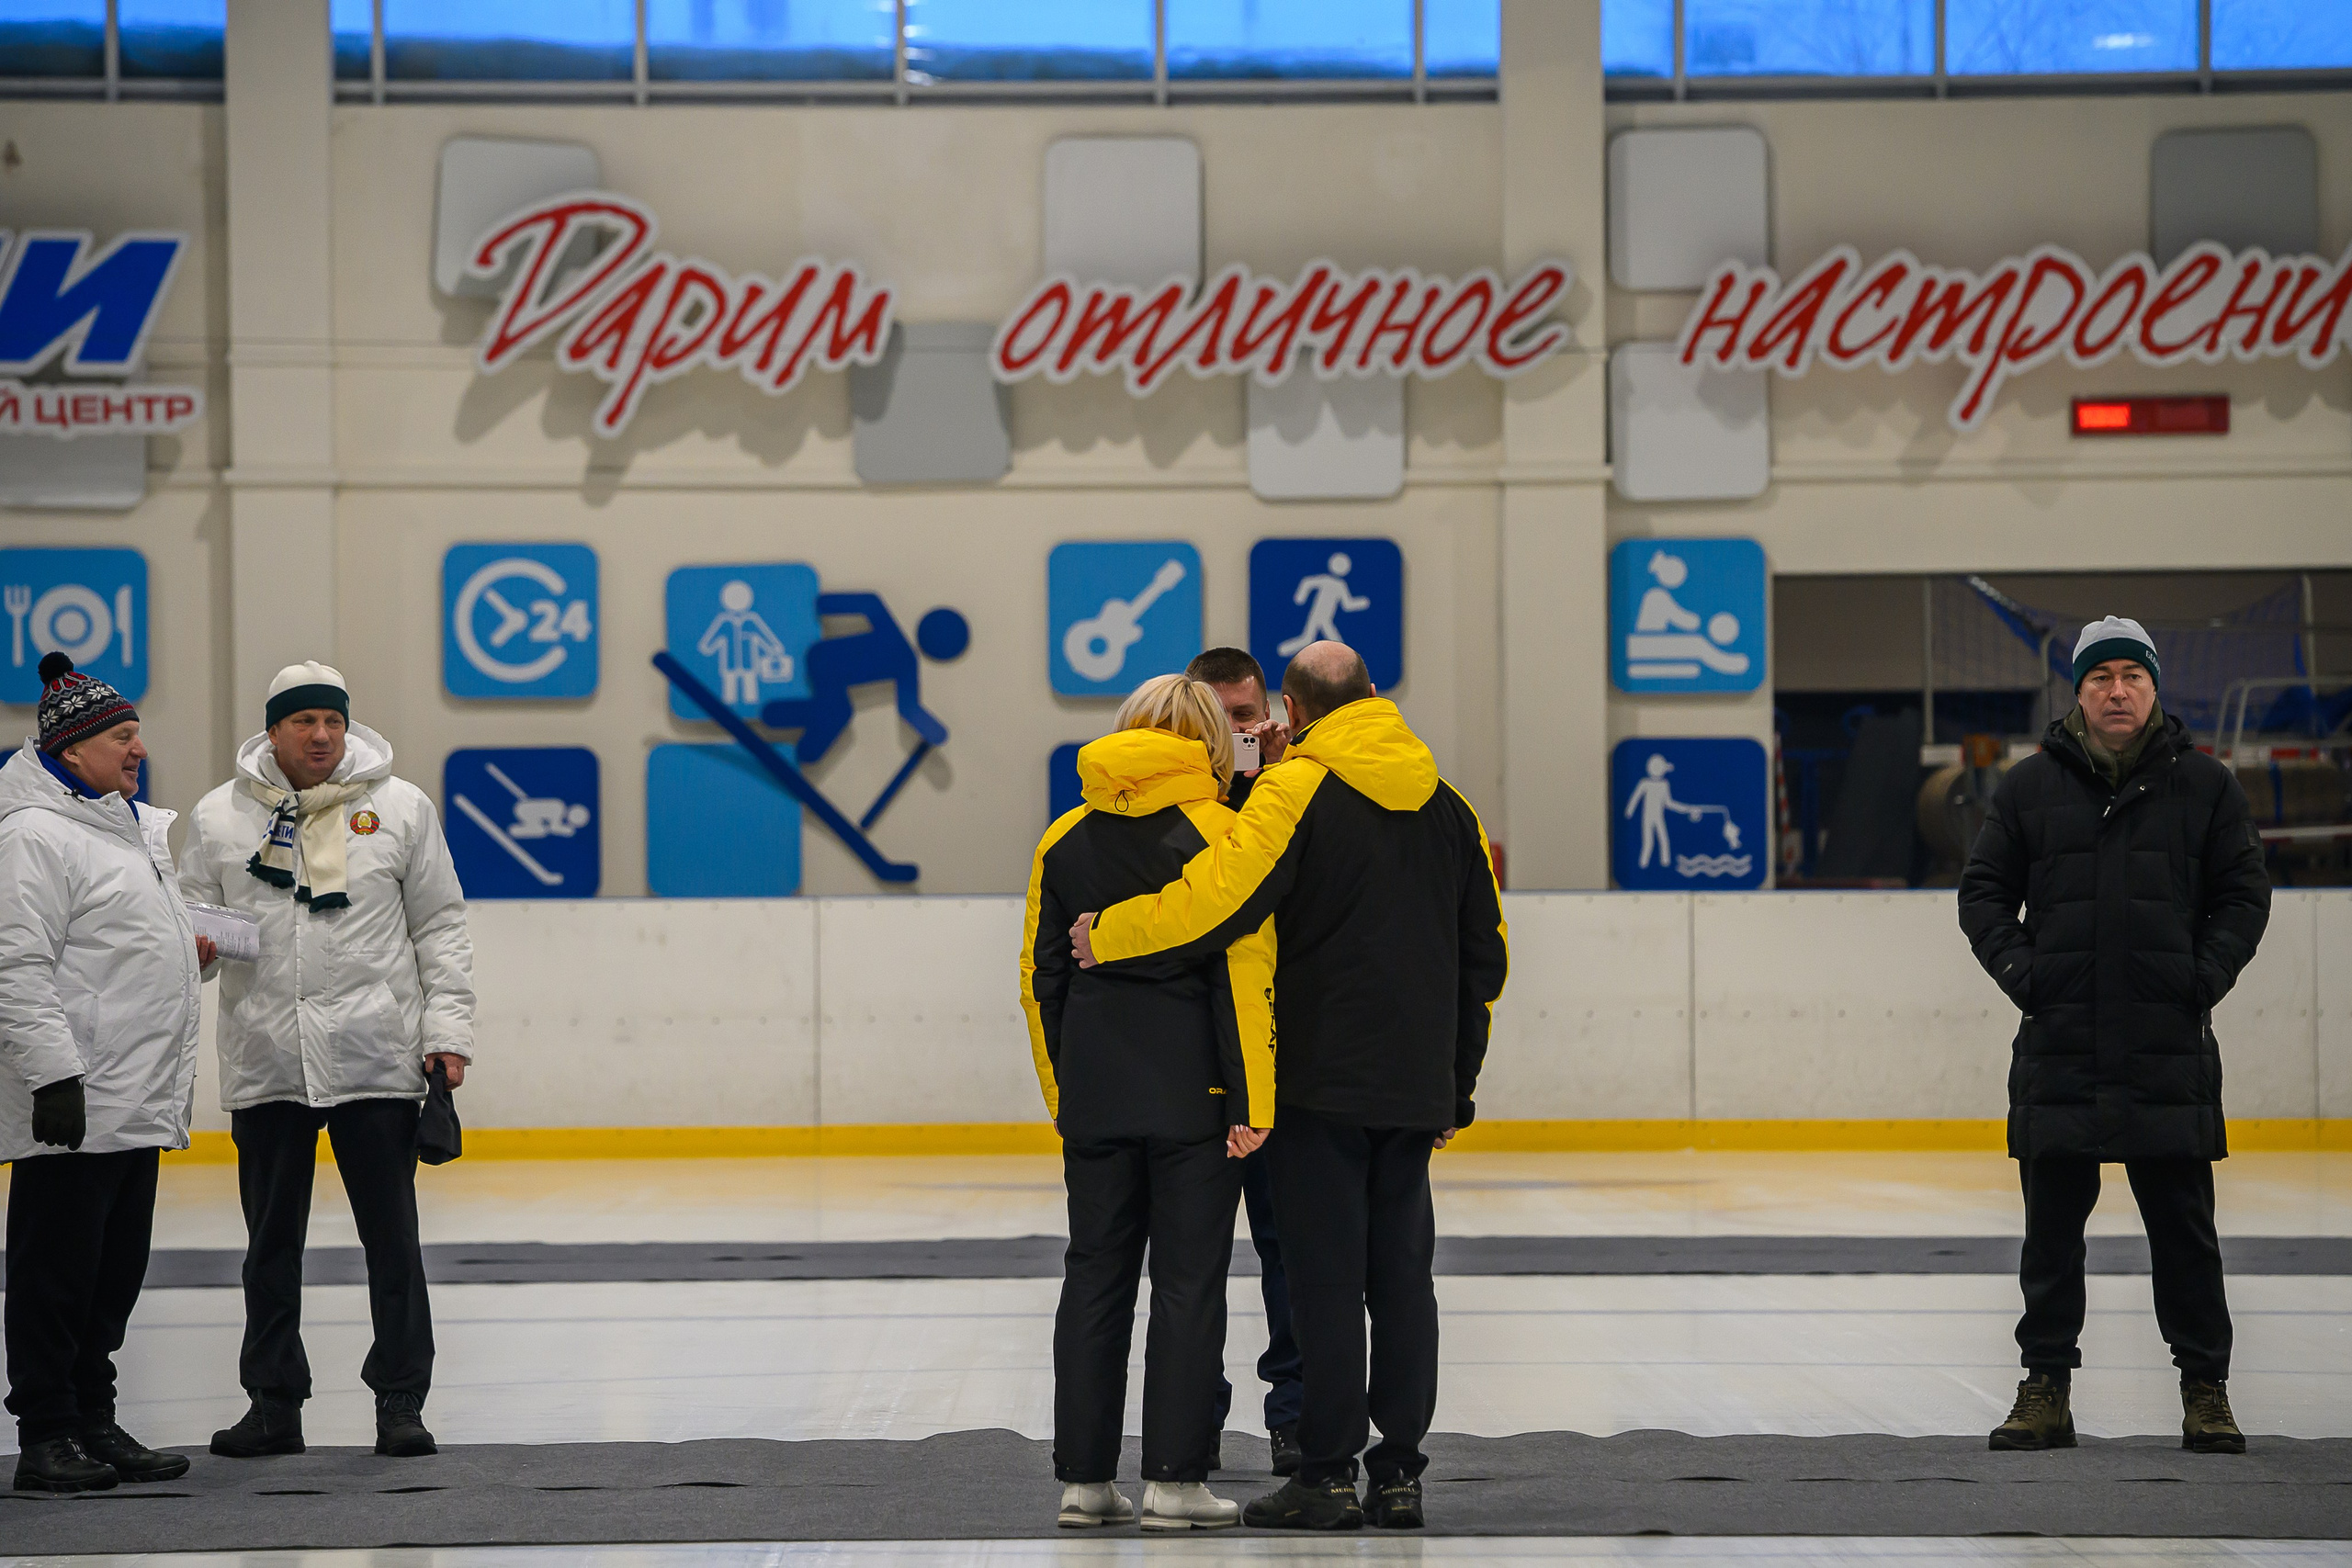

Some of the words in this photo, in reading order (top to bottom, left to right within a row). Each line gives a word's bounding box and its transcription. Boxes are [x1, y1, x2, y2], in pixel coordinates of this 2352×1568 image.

[0, 238, 180, 362] И
[474, 200, 889, 428] Дарим
[999, 266, 1566, 388] отличное
[1680, 253, 2352, 422] настроени
[34, 392, 195, 432] ЦЕНТР
[529, 599, 593, 642] 24
